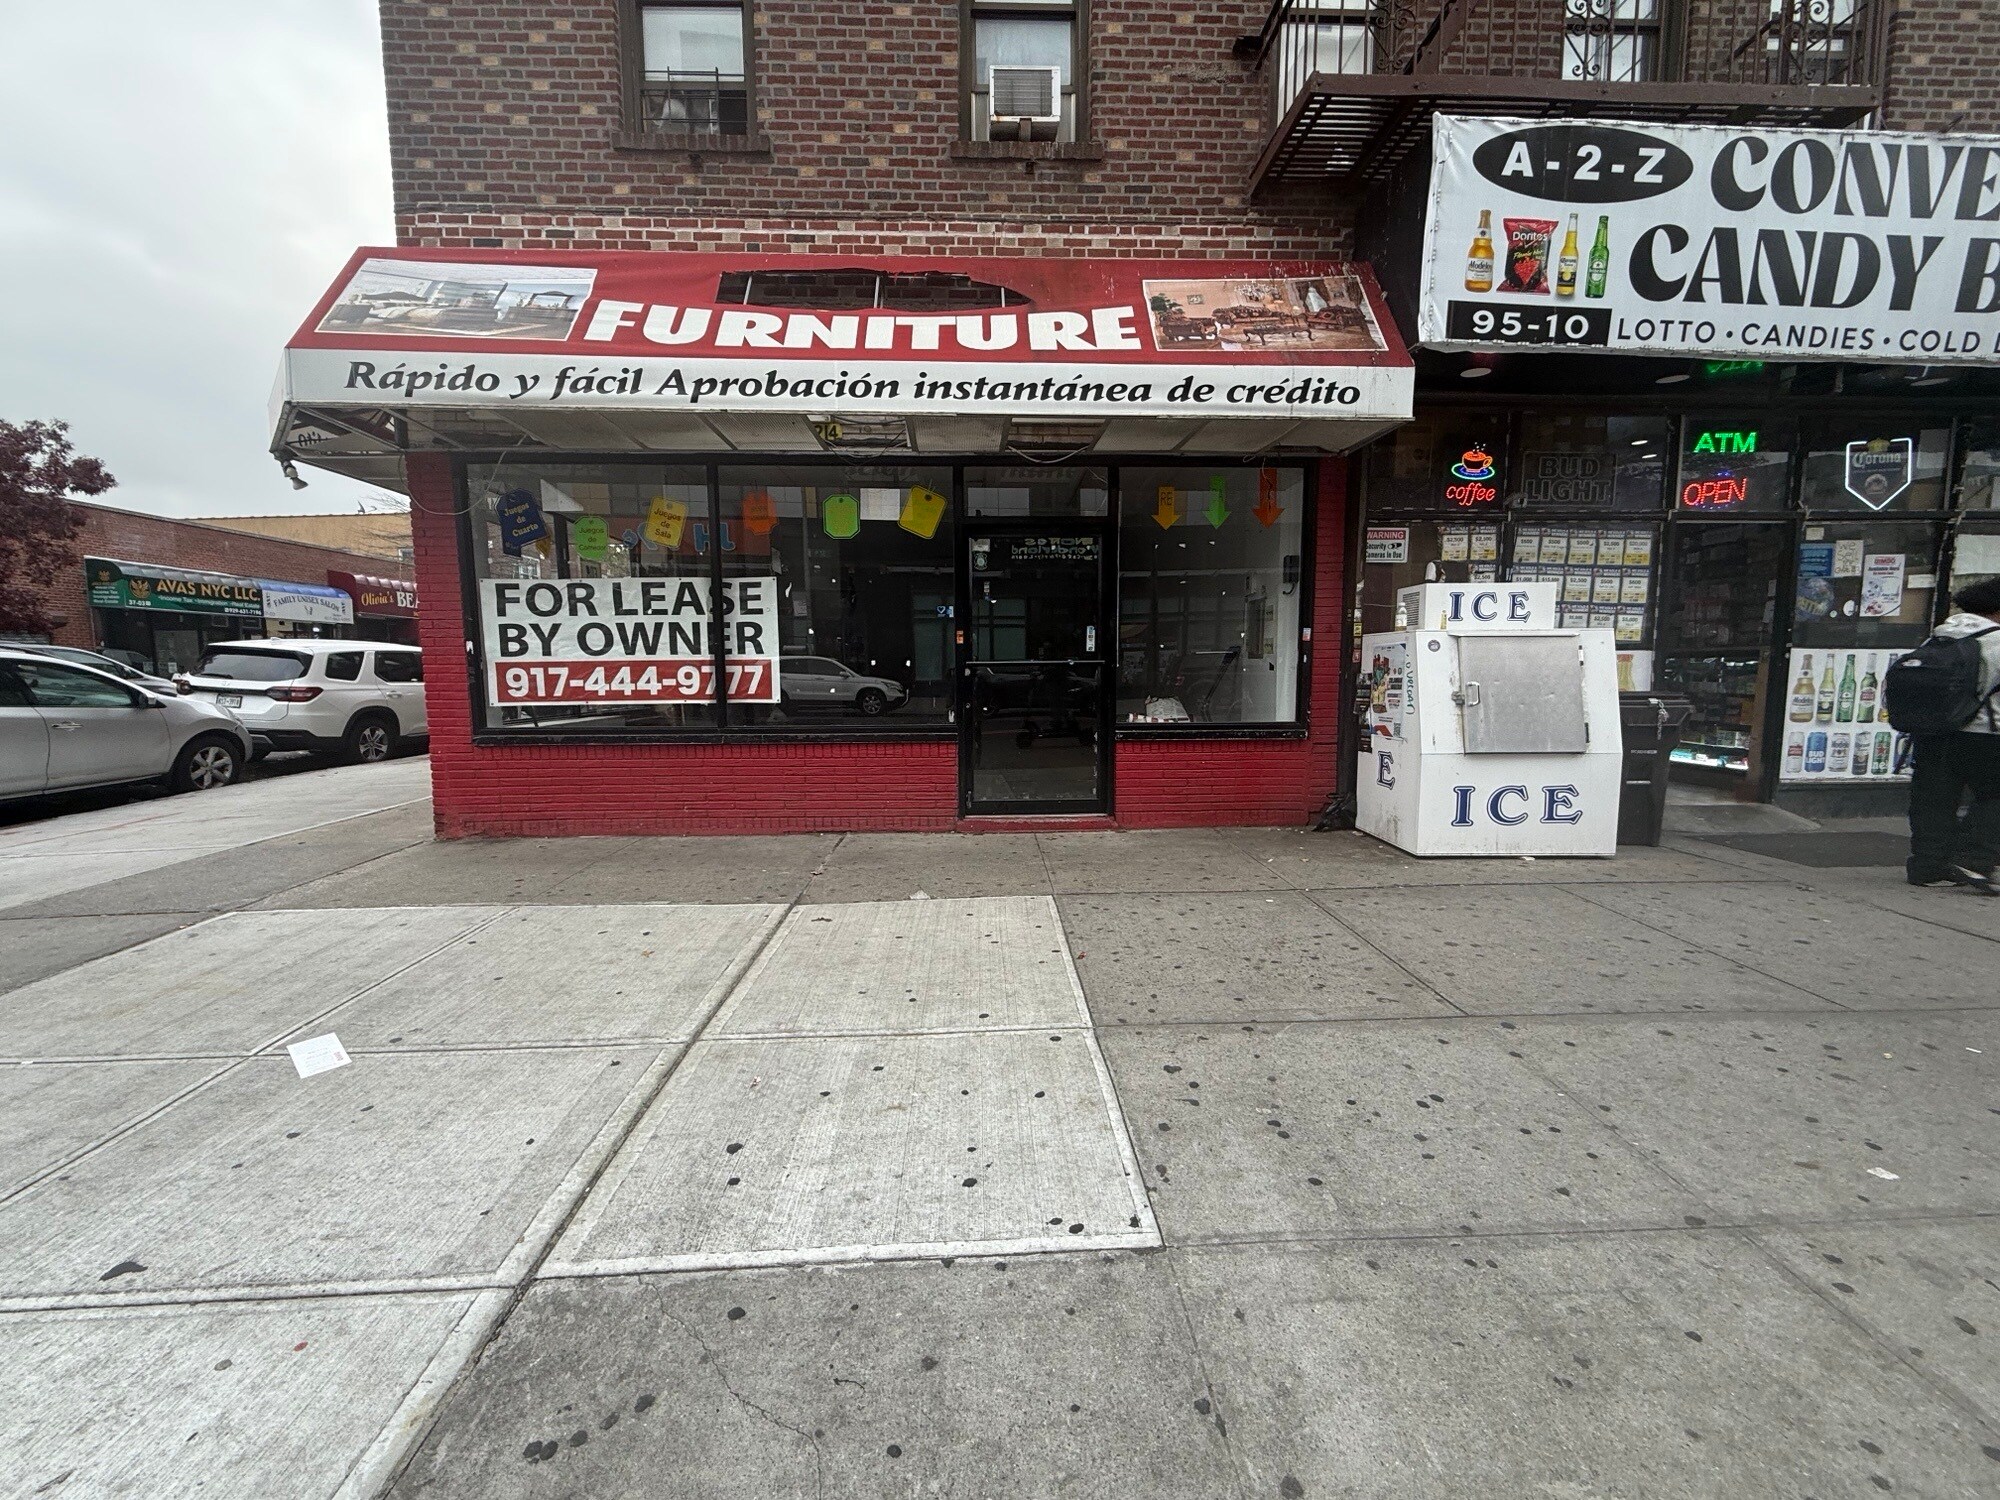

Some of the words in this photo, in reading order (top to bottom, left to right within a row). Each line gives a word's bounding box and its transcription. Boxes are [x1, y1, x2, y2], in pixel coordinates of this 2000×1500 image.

[1710, 136, 2000, 221] CONVE
[1512, 231, 1548, 242] Doritos
[1628, 223, 1945, 312] CANDY
[583, 300, 1141, 351] FURNITURE
[1472, 310, 1589, 339] 95-10
[1618, 318, 1716, 343] LOTTO
[1741, 323, 1875, 350] CANDIES
[1899, 329, 1980, 353] COLD
[344, 361, 501, 398] Rápido
[510, 373, 543, 399] y
[551, 365, 643, 400] fácil
[655, 369, 900, 403] Aprobación
[913, 372, 1153, 403] instantánea
[1167, 375, 1216, 403] de
[1226, 376, 1360, 405] crédito
[1693, 432, 1757, 453] ATM
[1538, 456, 1601, 478] BUD
[1852, 452, 1901, 468] Corona
[1446, 482, 1496, 506] coffee
[1525, 479, 1612, 502] LIGHT
[1683, 477, 1747, 506] OPEN
[504, 503, 530, 517] Juegos
[654, 508, 681, 522] Juegos
[512, 523, 539, 537] Cuarto
[654, 529, 672, 540] Sala
[660, 520, 671, 529] de
[1367, 531, 1404, 540] WARNING
[157, 580, 196, 595] AVAS
[201, 583, 230, 599] NYC
[234, 586, 261, 601] LLC.
[361, 591, 395, 606] Olivia's
[495, 583, 599, 617] FOR
[612, 582, 764, 617] LEASE
[273, 595, 296, 607] FAMILY
[297, 595, 319, 606] UNISEX
[320, 598, 340, 612] SALON
[1448, 591, 1531, 624] ICE
[498, 623, 561, 657] BY
[577, 621, 764, 656] OWNER
[505, 666, 763, 697] 917-444-9777
[1451, 784, 1583, 827] ICE
